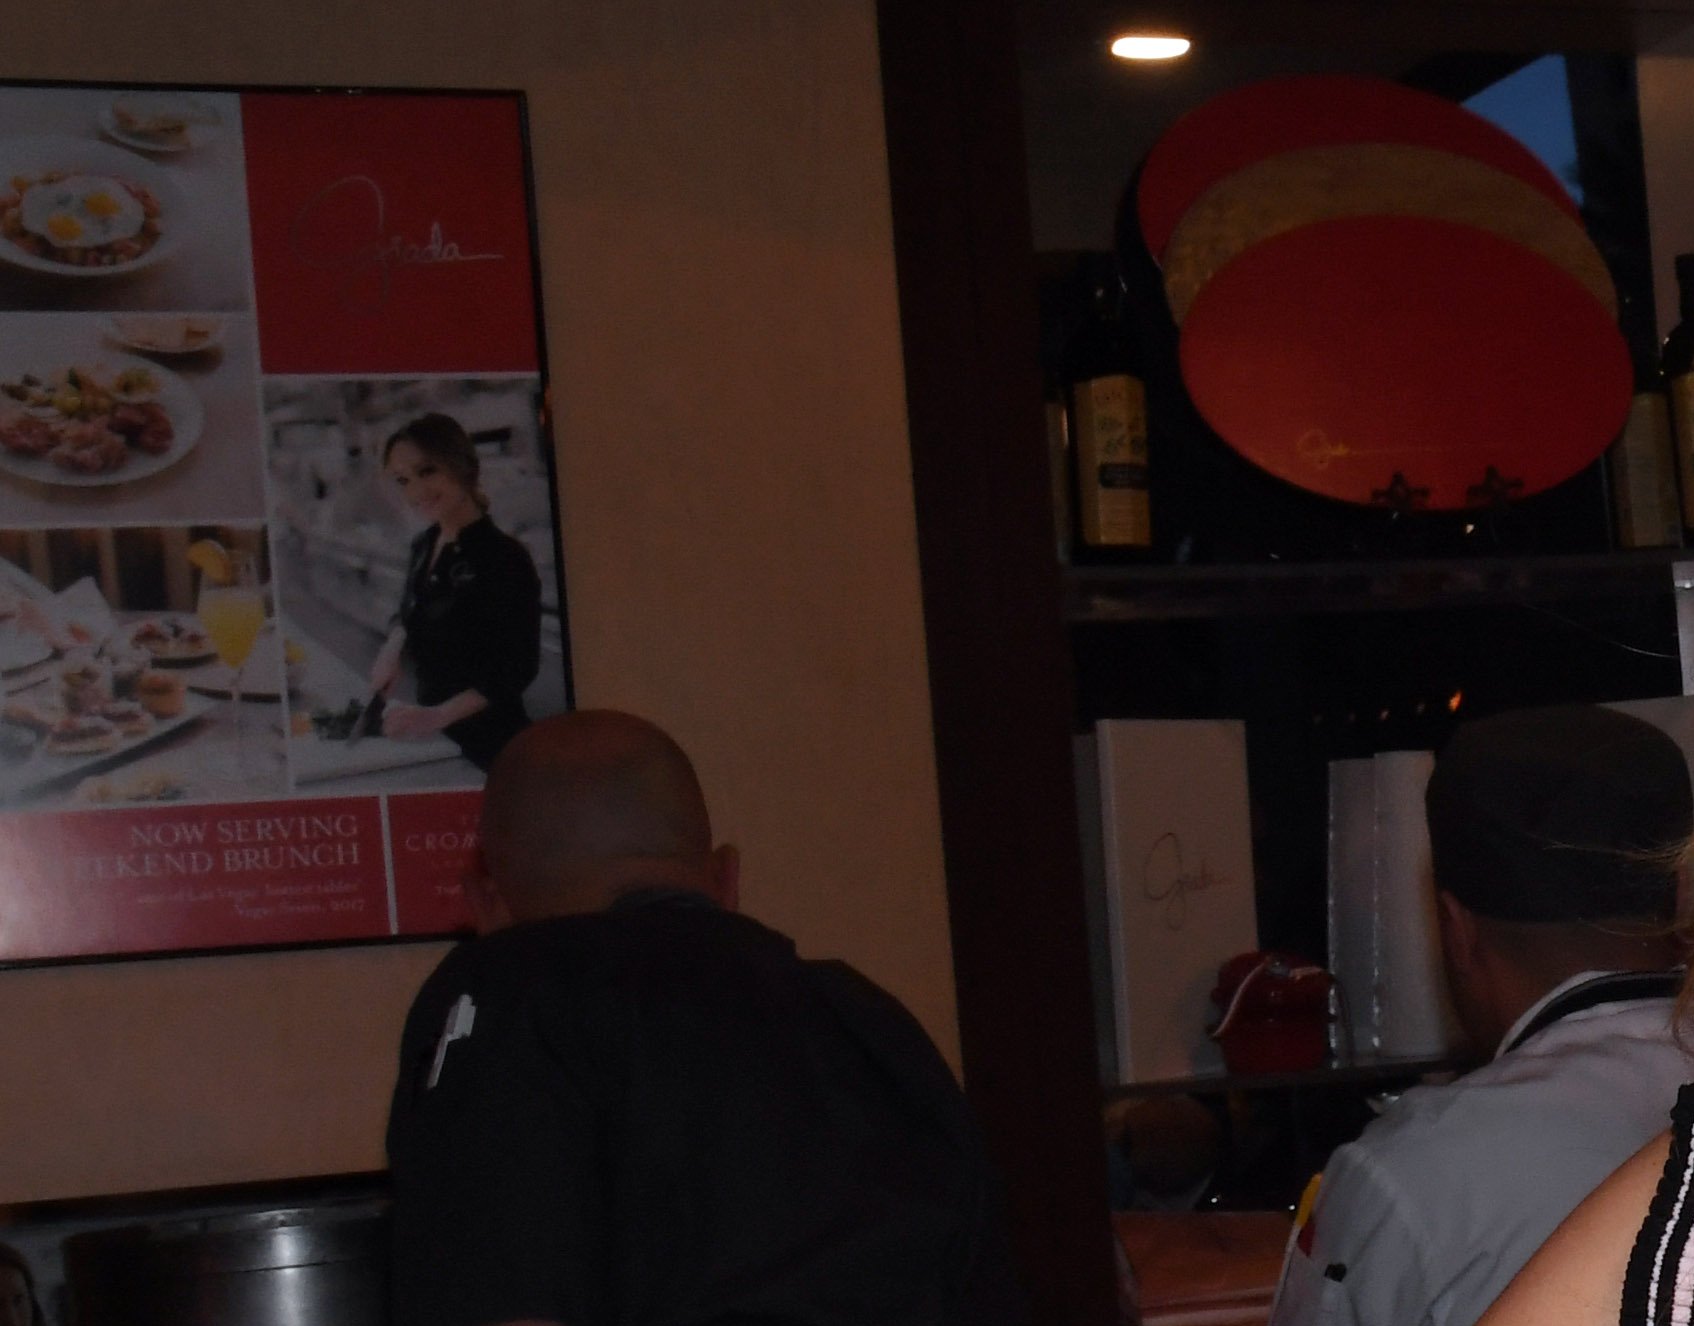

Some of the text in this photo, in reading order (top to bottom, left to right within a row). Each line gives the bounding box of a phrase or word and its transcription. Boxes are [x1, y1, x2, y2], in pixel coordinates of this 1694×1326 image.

[130, 814, 358, 848] NOW SERVING
[222, 842, 360, 872] BRUNCH
